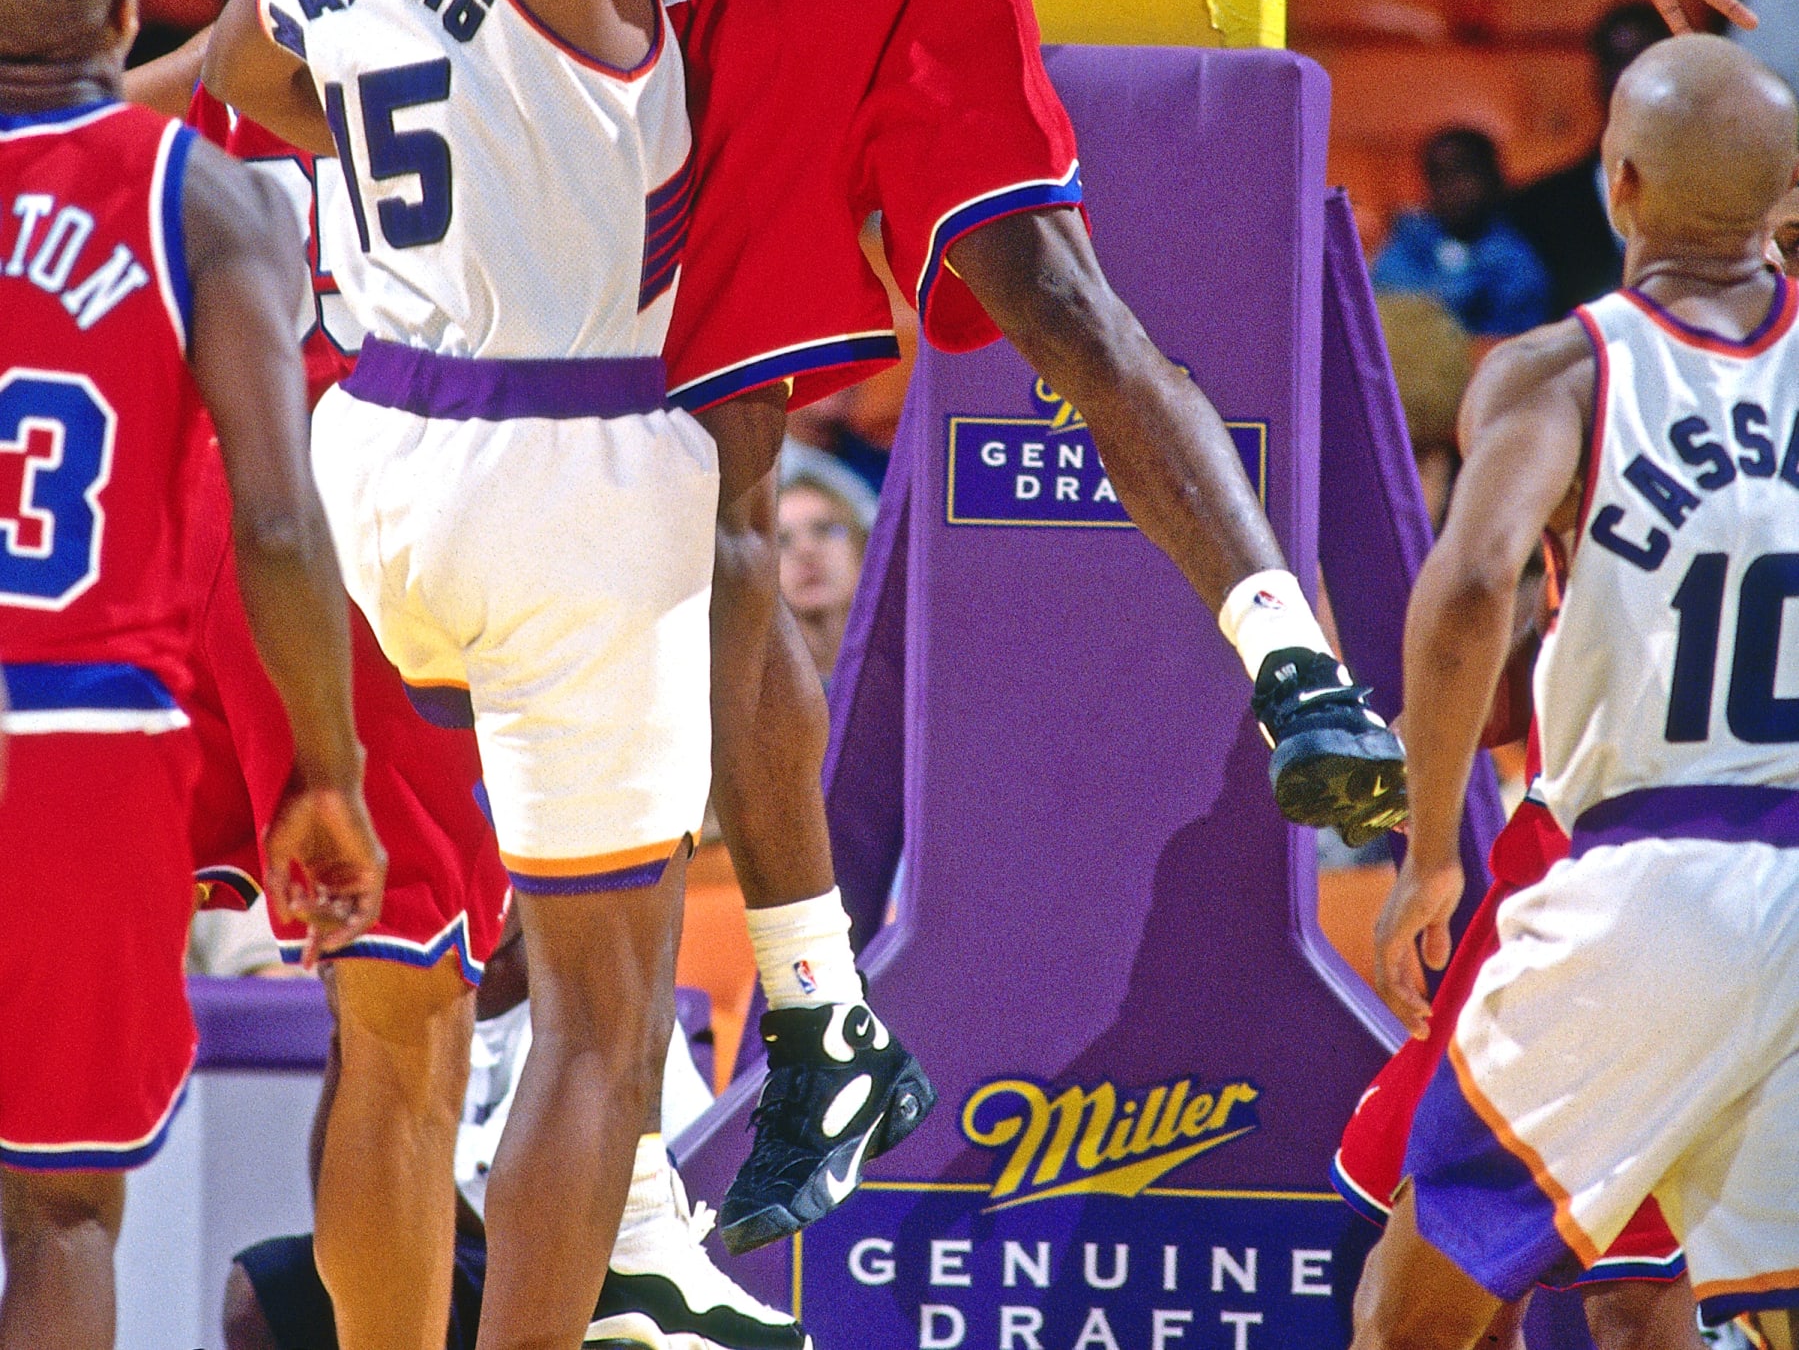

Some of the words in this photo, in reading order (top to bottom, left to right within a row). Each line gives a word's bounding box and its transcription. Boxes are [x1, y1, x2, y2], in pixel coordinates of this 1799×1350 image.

[325, 56, 452, 253] 15
[0, 193, 150, 331] TON
[981, 440, 1104, 469] GEN
[1665, 552, 1799, 744] 10
[962, 1079, 1259, 1199] Miller
[848, 1236, 1334, 1297] GENUINE
[917, 1303, 1264, 1350] DRAFT
